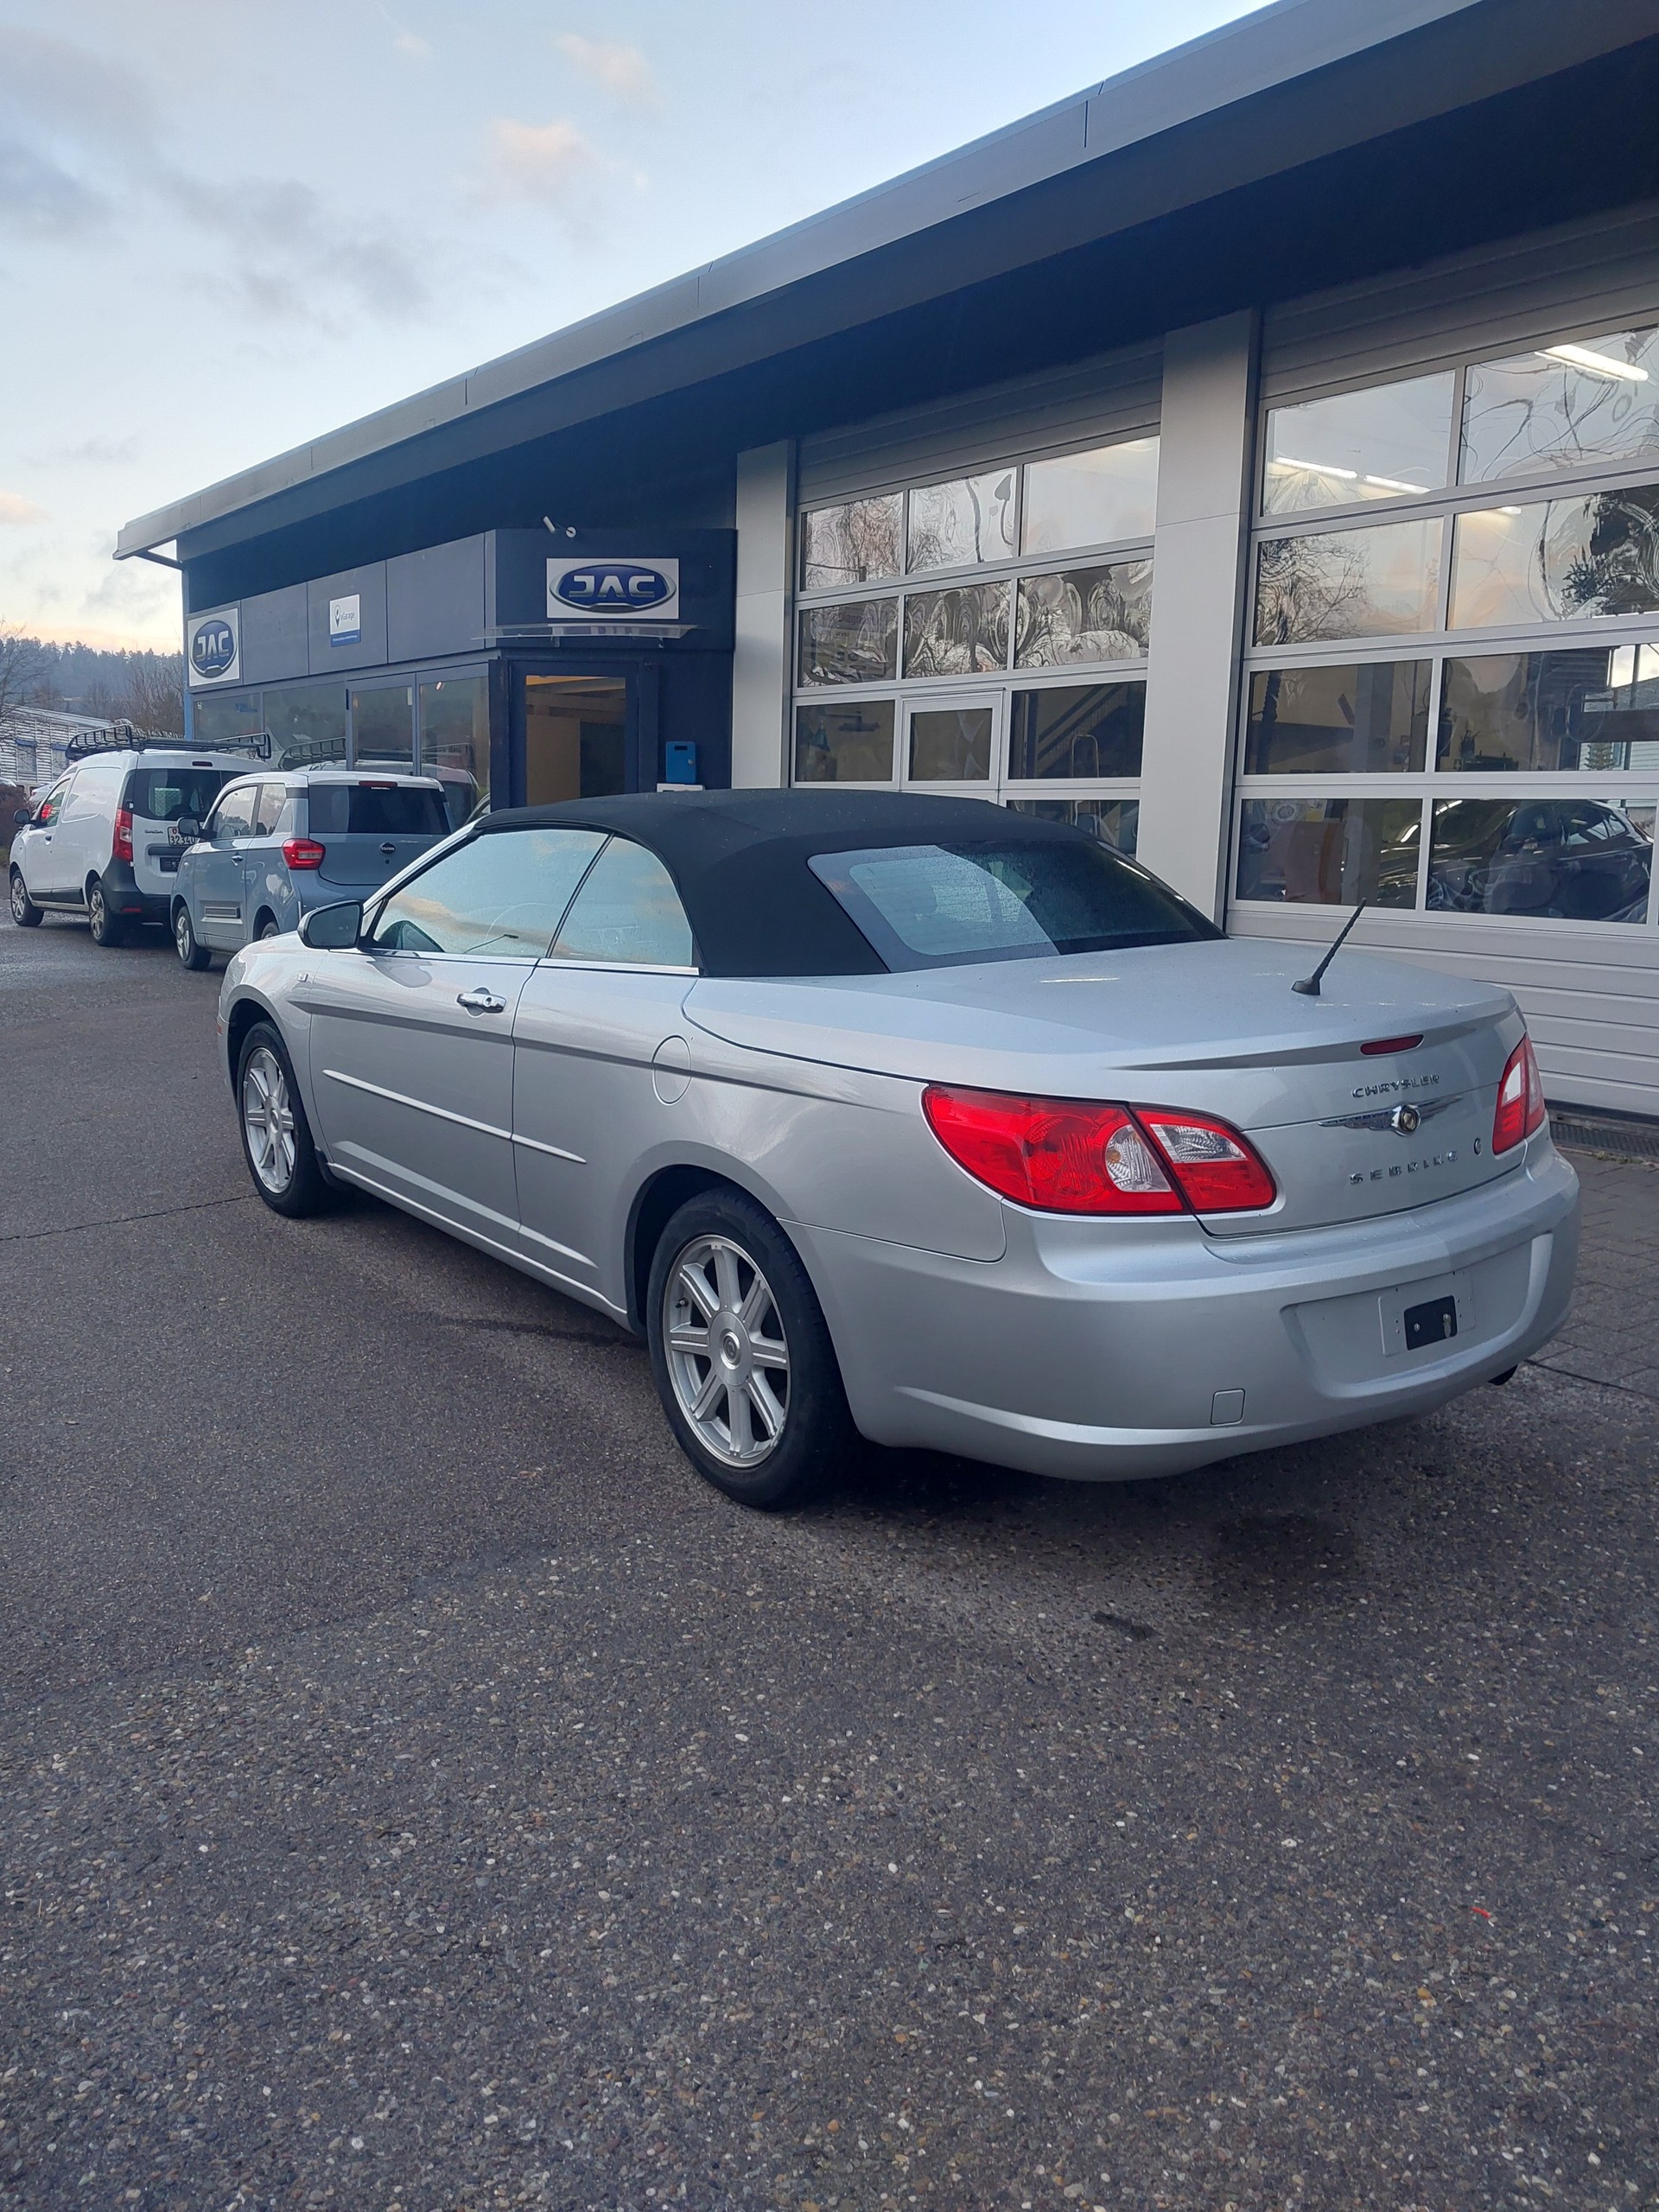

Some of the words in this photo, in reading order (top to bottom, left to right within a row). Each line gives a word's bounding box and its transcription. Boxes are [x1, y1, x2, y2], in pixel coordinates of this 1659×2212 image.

[569, 575, 655, 597] JAC
[195, 630, 229, 662] JAC
[1352, 1074, 1440, 1098] CHRYSLER
[1350, 1150, 1459, 1185] SEBRING
